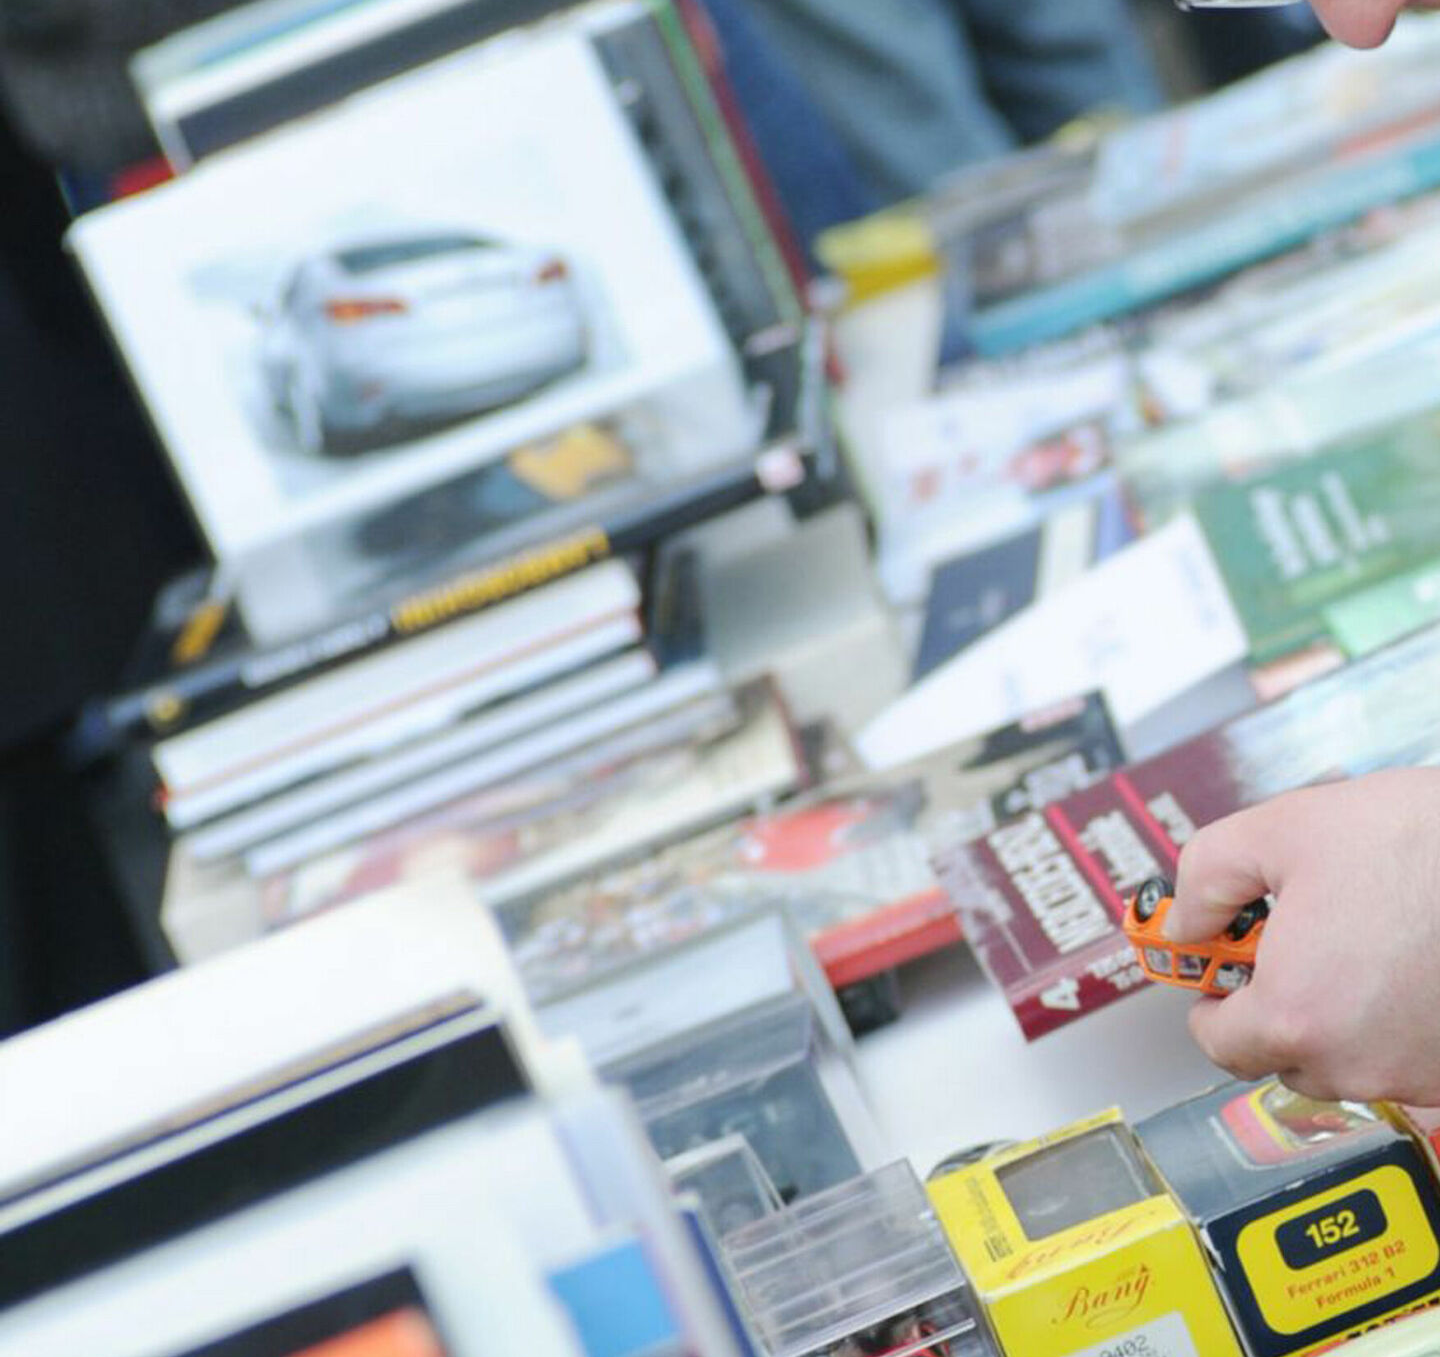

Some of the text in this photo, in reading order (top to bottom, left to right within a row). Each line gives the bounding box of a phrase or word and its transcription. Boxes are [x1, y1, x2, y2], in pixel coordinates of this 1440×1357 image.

[1305, 1209, 1360, 1249] 152
[1286, 1269, 1347, 1300] Ferrari
[1347, 1251, 1380, 1276] 312
[1315, 1277, 1383, 1310] Formula
